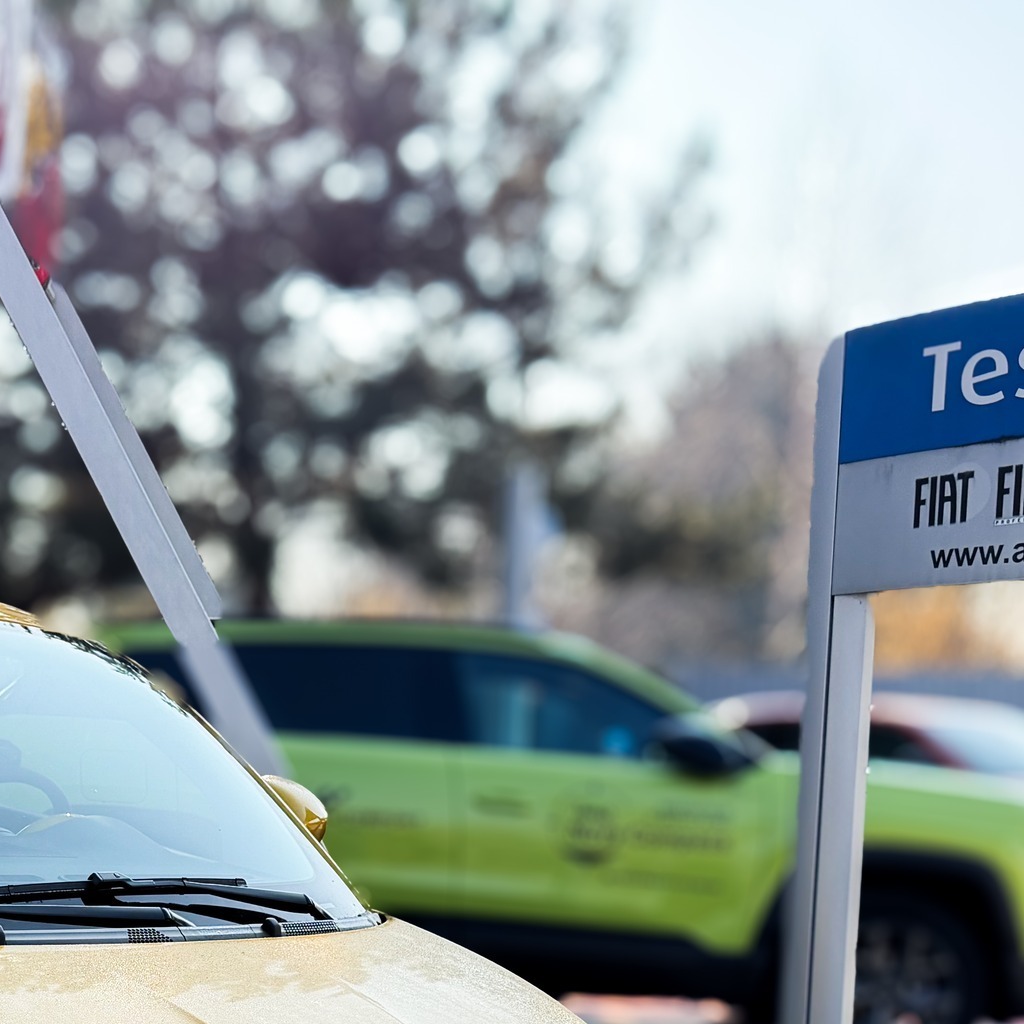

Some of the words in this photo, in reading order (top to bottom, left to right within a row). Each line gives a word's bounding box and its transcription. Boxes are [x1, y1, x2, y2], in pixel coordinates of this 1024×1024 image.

[922, 340, 1024, 412] Te
[913, 470, 975, 529] FIAT
[995, 464, 1024, 518] FI
